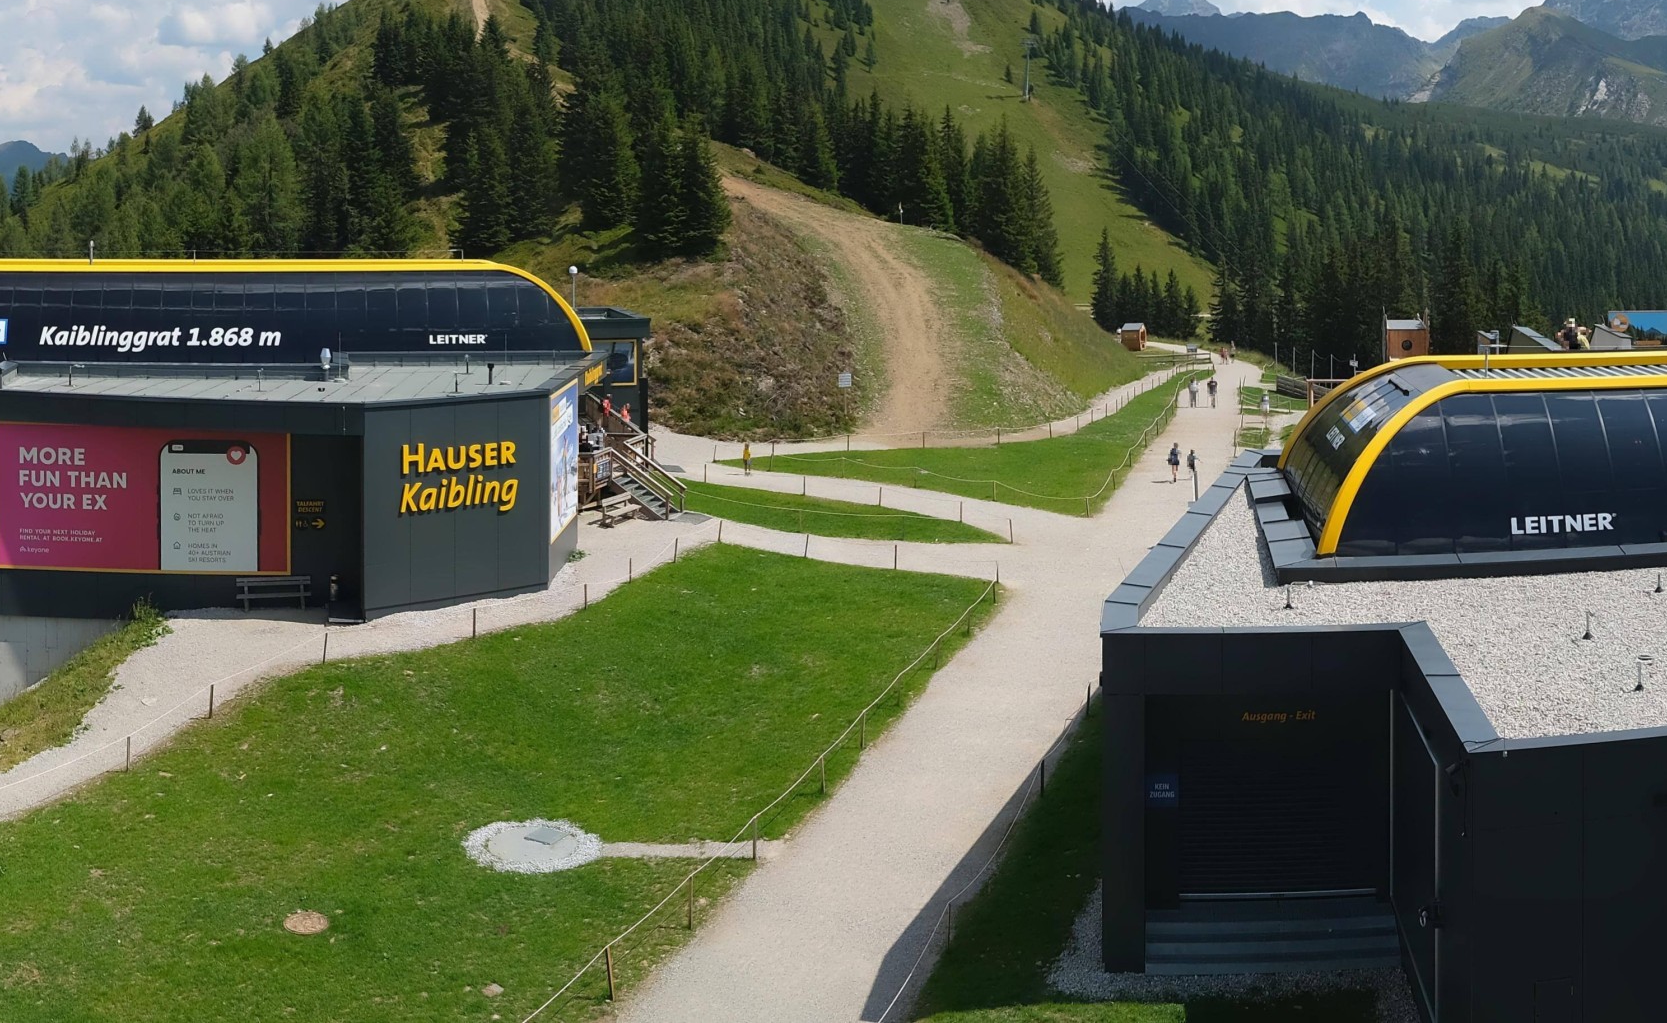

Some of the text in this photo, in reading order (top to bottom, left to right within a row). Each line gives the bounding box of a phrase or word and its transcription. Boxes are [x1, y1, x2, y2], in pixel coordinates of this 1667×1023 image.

[39, 325, 281, 352] Kaiblinggrat 1.868 m
[429, 334, 486, 345] LEITNER
[19, 447, 86, 465] MORE
[402, 441, 516, 474] HAUSER
[19, 470, 126, 488] FUN THAN
[20, 492, 107, 510] YOUR EX
[400, 474, 518, 512] Kaibling
[1511, 513, 1614, 534] LEITNER
[1242, 711, 1287, 724] Ausgang
[1296, 710, 1316, 720] Exit
